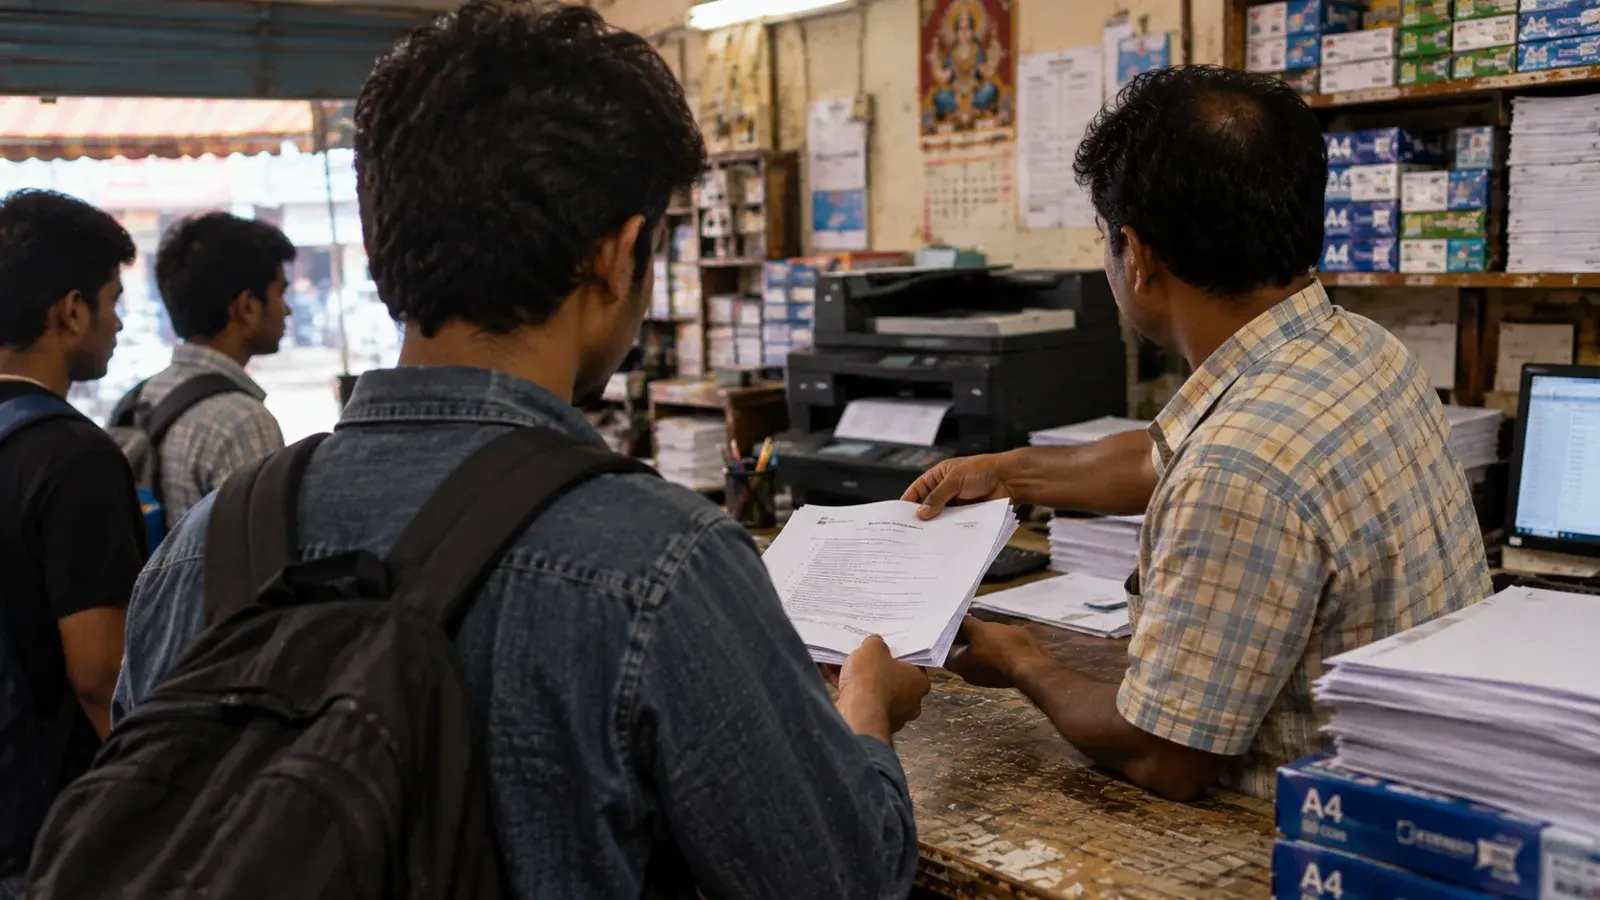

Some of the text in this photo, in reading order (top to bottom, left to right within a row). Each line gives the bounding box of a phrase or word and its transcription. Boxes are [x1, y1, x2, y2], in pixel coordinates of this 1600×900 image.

[1523, 15, 1549, 34] A4
[1327, 137, 1351, 158] A4
[1325, 170, 1351, 192] A4
[1324, 208, 1348, 228] A4
[1324, 244, 1349, 263] A4
[1302, 787, 1343, 823] A4
[1301, 862, 1343, 899] A4
